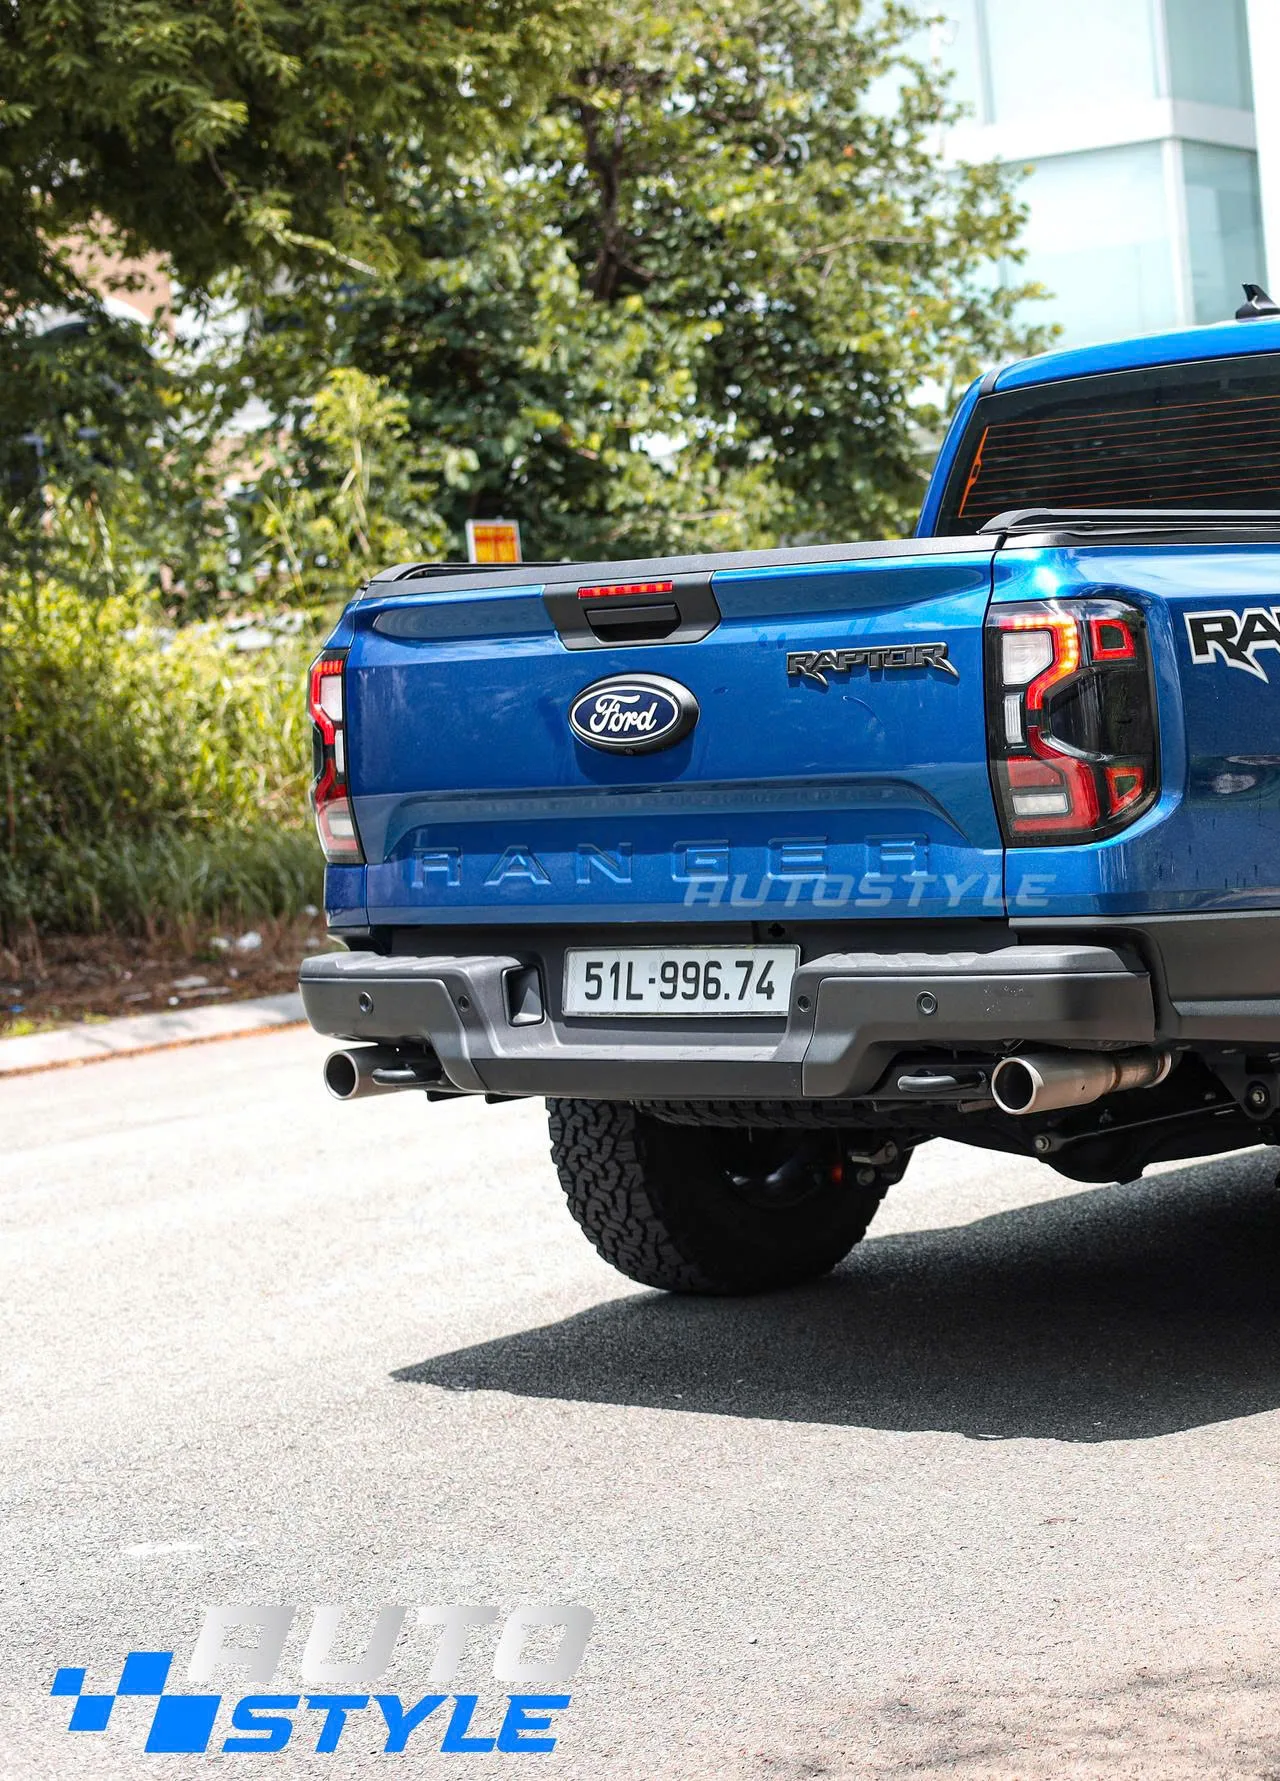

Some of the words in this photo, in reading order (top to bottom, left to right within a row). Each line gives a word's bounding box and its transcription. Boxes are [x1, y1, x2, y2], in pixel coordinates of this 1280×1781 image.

[786, 641, 960, 687] RAPTOR
[590, 694, 658, 733] Ford
[411, 833, 930, 889] RANGER
[584, 959, 775, 1001] 51L-996.74
